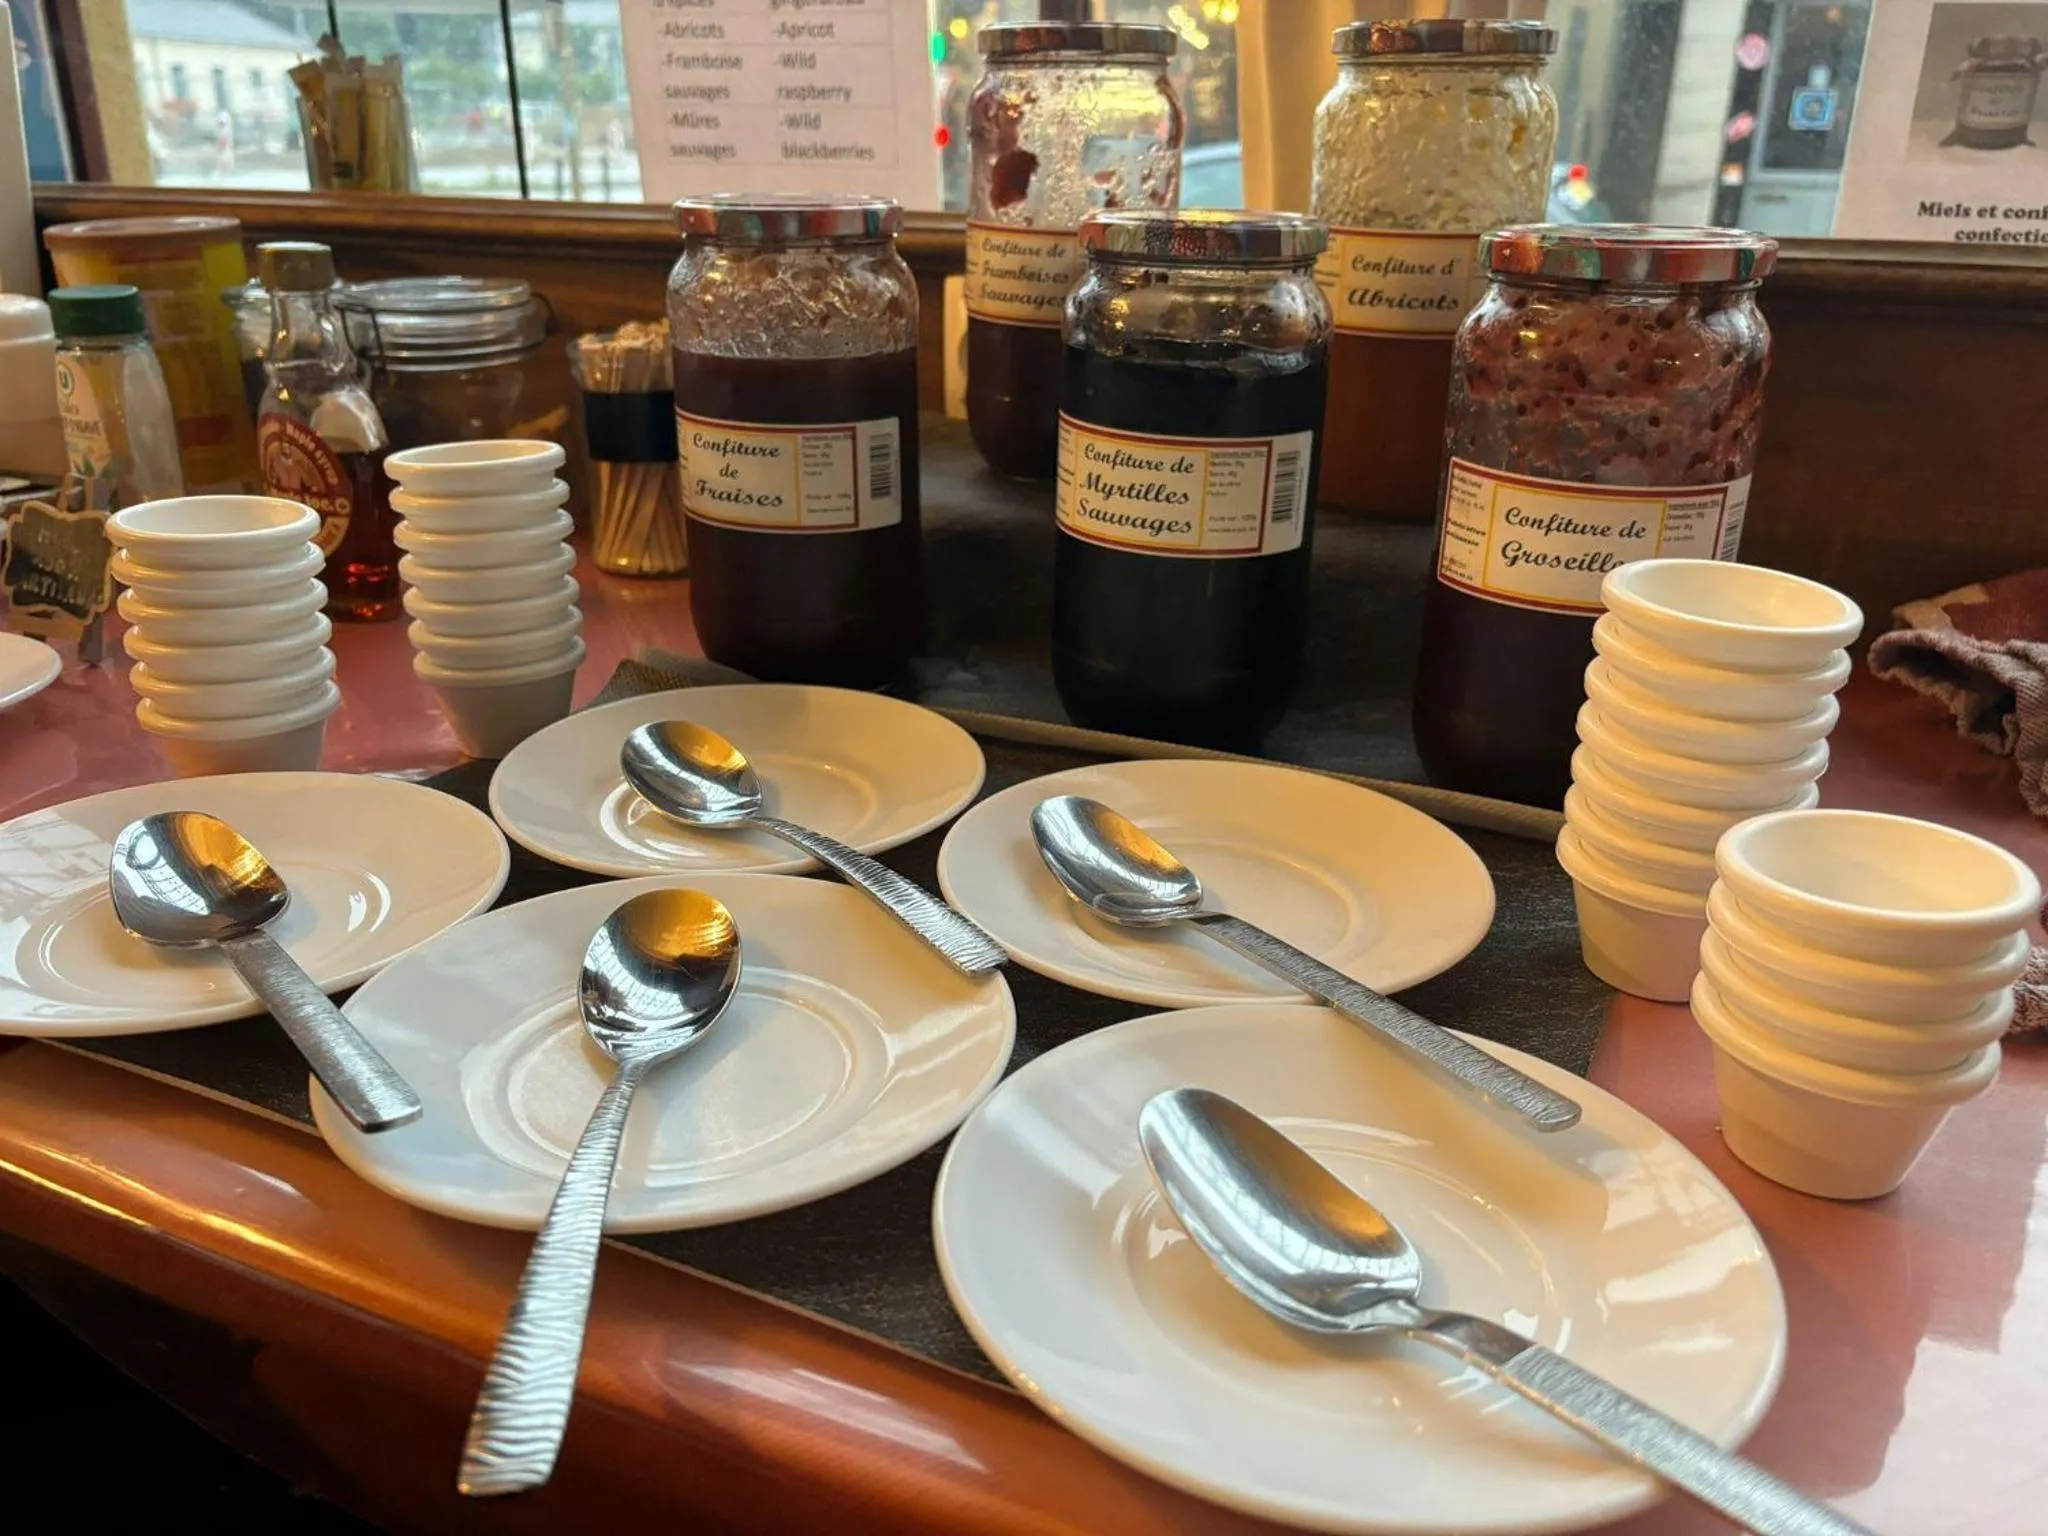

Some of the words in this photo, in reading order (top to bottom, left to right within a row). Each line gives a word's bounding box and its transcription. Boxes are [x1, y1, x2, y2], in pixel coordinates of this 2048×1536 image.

[664, 85, 730, 102] sauvages
[776, 84, 851, 102] raspberry
[669, 144, 737, 161] sauvages
[781, 142, 875, 161] blackberries
[1918, 201, 1972, 218] Miels
[1977, 205, 1998, 218] et
[982, 237, 1042, 257] Confiture
[1046, 243, 1065, 258] de
[982, 260, 1069, 283] Framboises
[1351, 254, 1436, 278] Confiture
[1348, 288, 1459, 311] Abricots
[692, 432, 781, 458] Confiture
[1084, 443, 1165, 471] Confiture
[1170, 456, 1195, 474] de
[719, 463, 739, 479] de
[696, 480, 784, 507] Fraises
[1079, 472, 1190, 505] Myrtilles
[1077, 499, 1192, 537] Sauvages
[1504, 506, 1611, 538] Confiture
[1618, 519, 1647, 539] de
